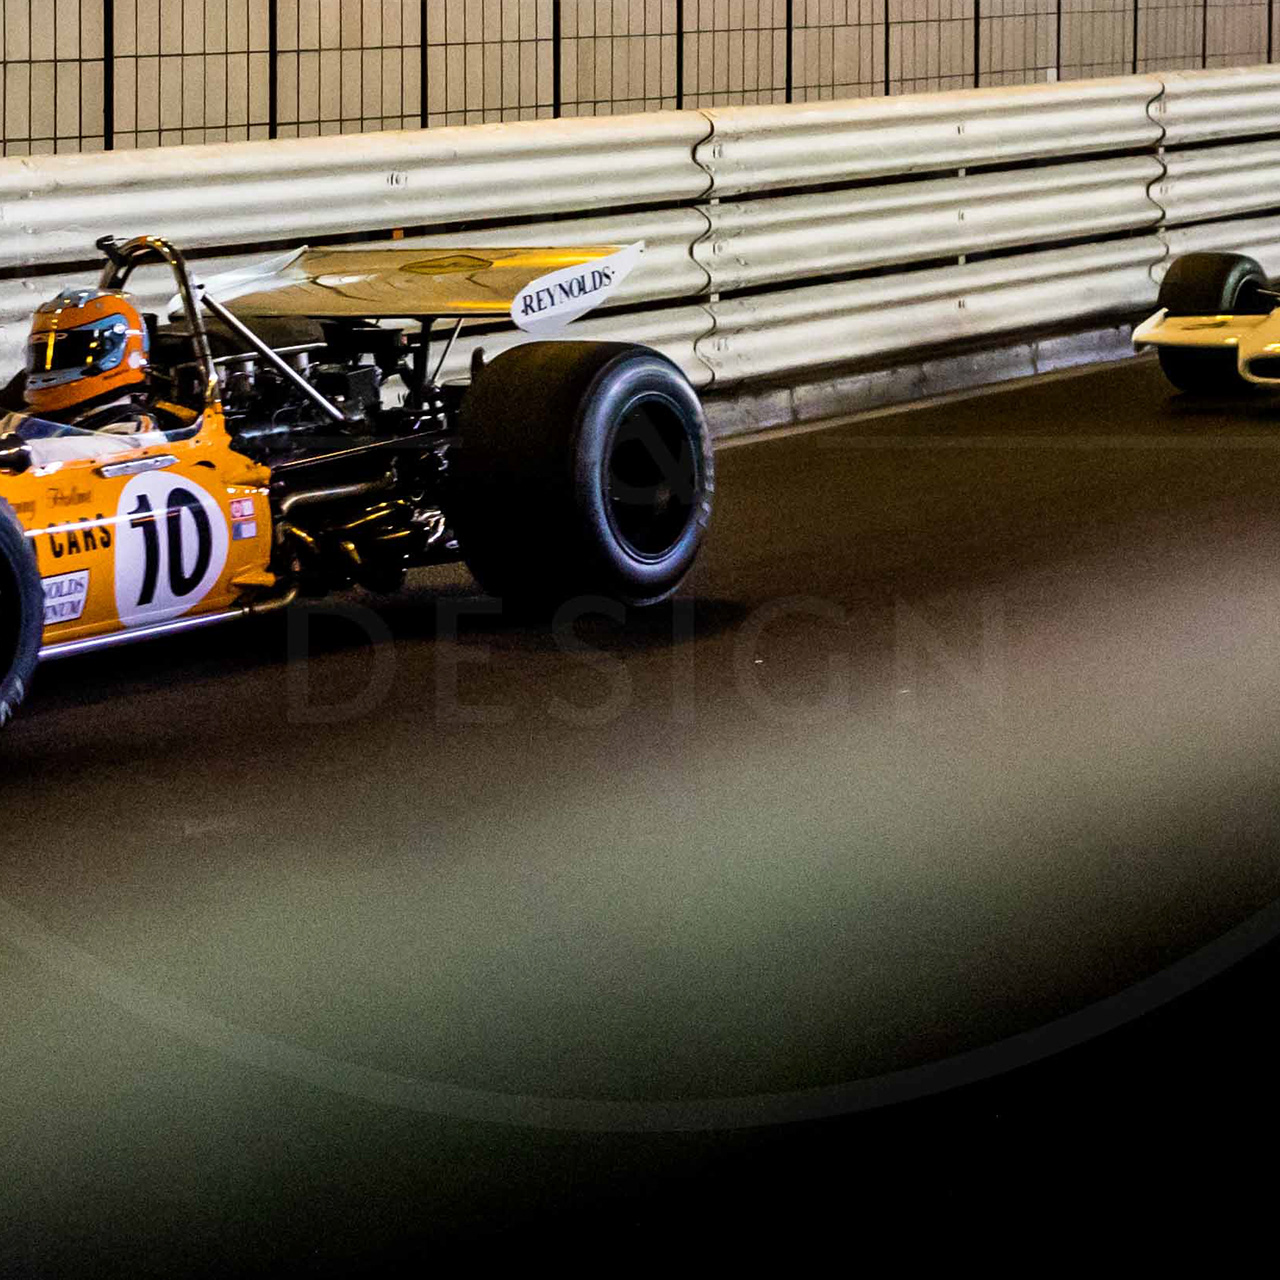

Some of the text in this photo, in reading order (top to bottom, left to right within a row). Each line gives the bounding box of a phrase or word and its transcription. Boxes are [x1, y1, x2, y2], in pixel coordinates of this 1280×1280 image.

[521, 265, 613, 316] REYNOLDS
[47, 512, 112, 559] CARS
[127, 487, 213, 606] 10
